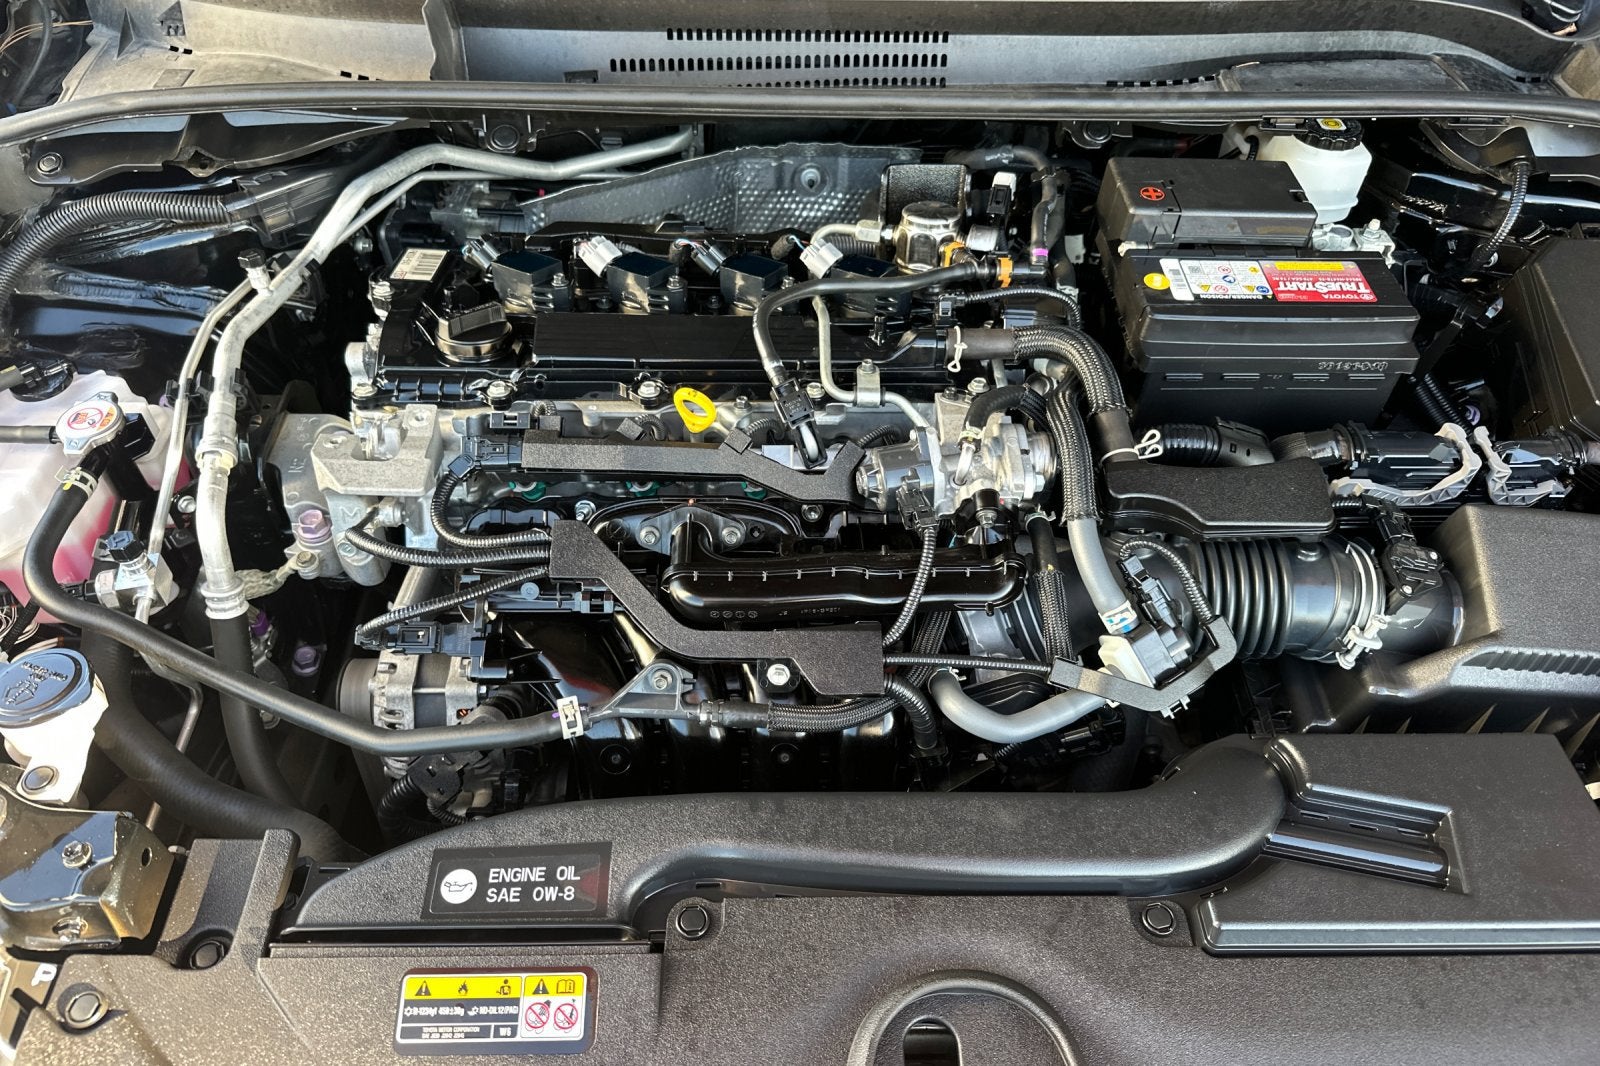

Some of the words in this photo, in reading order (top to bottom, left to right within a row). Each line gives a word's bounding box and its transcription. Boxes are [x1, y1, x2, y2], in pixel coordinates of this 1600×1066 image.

[488, 866, 547, 883] ENGINE
[556, 865, 581, 881] OIL
[486, 886, 522, 903] SAE
[532, 885, 575, 902] 0W-8
